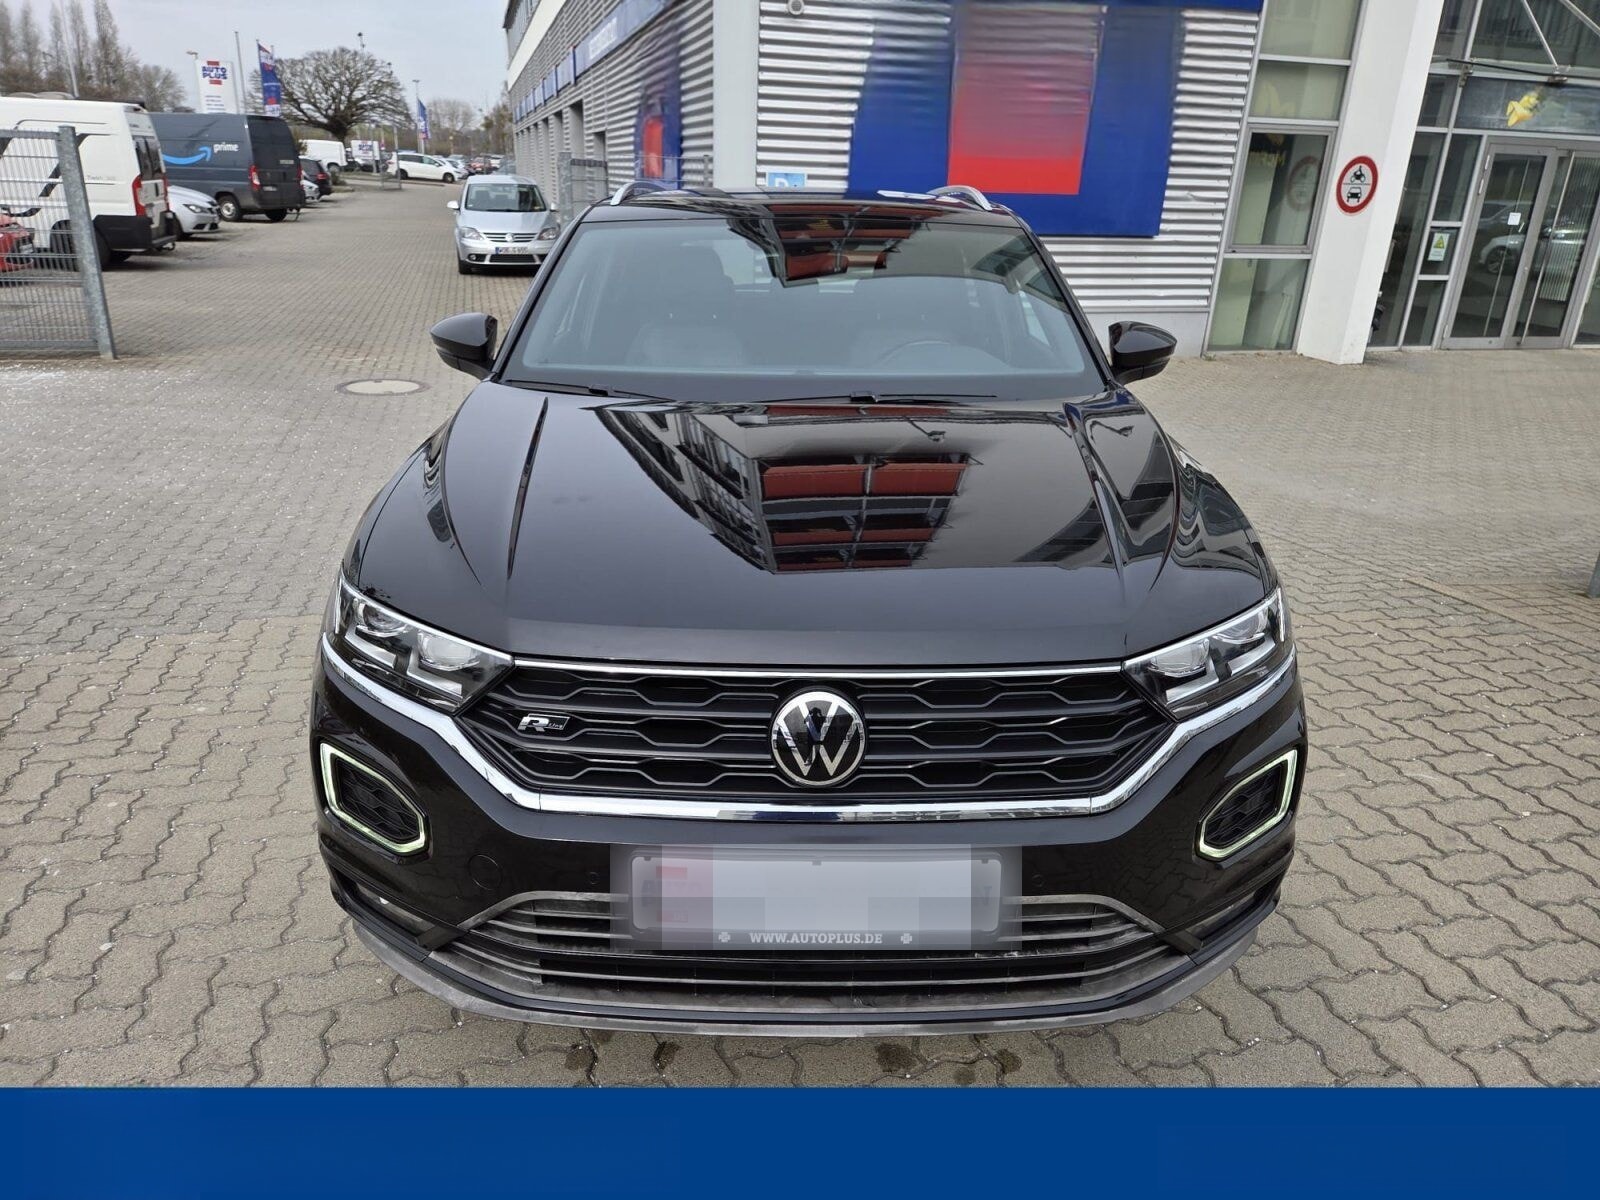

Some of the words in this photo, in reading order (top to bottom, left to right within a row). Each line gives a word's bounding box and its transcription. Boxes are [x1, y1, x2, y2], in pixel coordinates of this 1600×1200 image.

[202, 72, 228, 80] PLUS
[213, 142, 239, 153] prime
[749, 931, 883, 945] WWW.AUTOPLUS.DE
